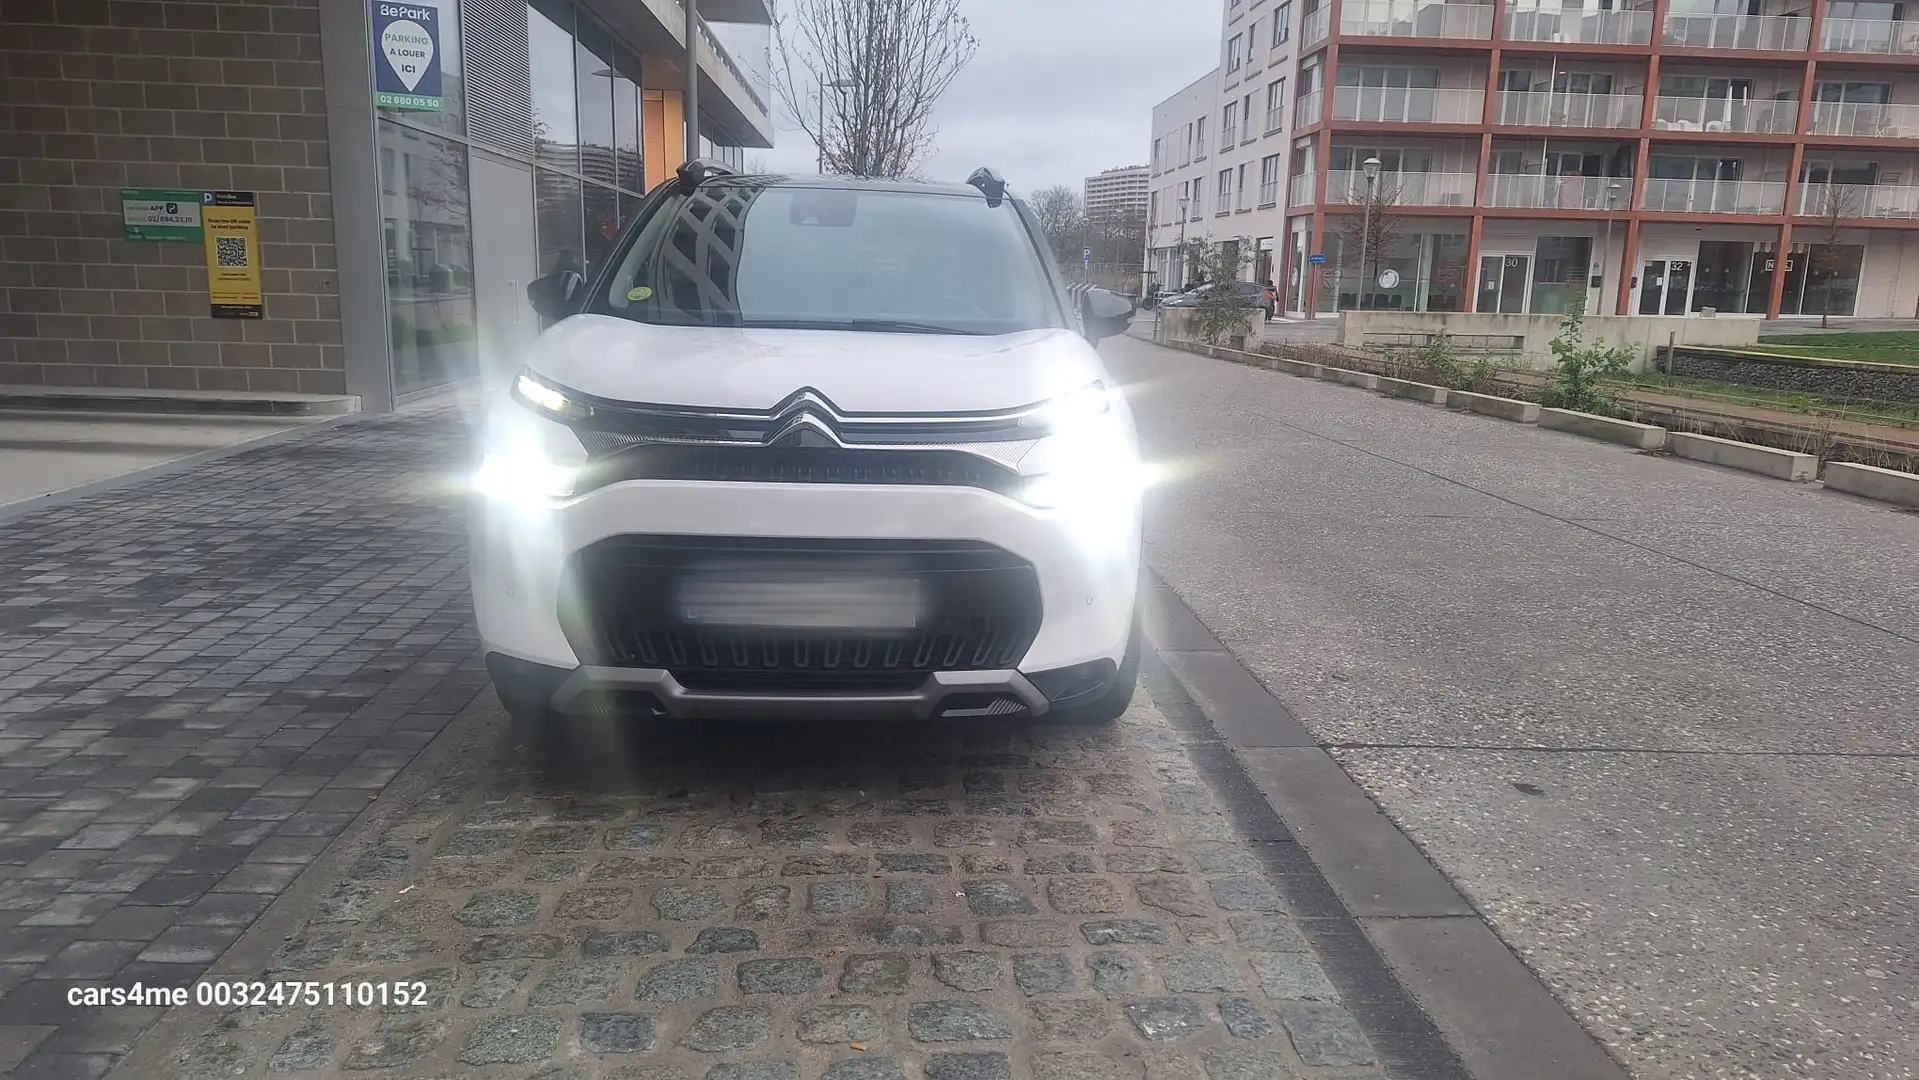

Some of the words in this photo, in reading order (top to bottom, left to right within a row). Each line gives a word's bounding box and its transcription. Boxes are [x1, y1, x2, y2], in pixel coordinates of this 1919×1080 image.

[380, 4, 431, 20] BePark
[385, 33, 429, 45] PARKING
[389, 48, 397, 56] A
[398, 49, 425, 59] LOUER
[401, 64, 416, 74] ICI
[380, 95, 392, 104] 02
[393, 97, 412, 105] 880
[413, 98, 425, 106] 05
[427, 99, 439, 107] 50
[1505, 258, 1518, 267] 30
[1671, 262, 1683, 271] 32
